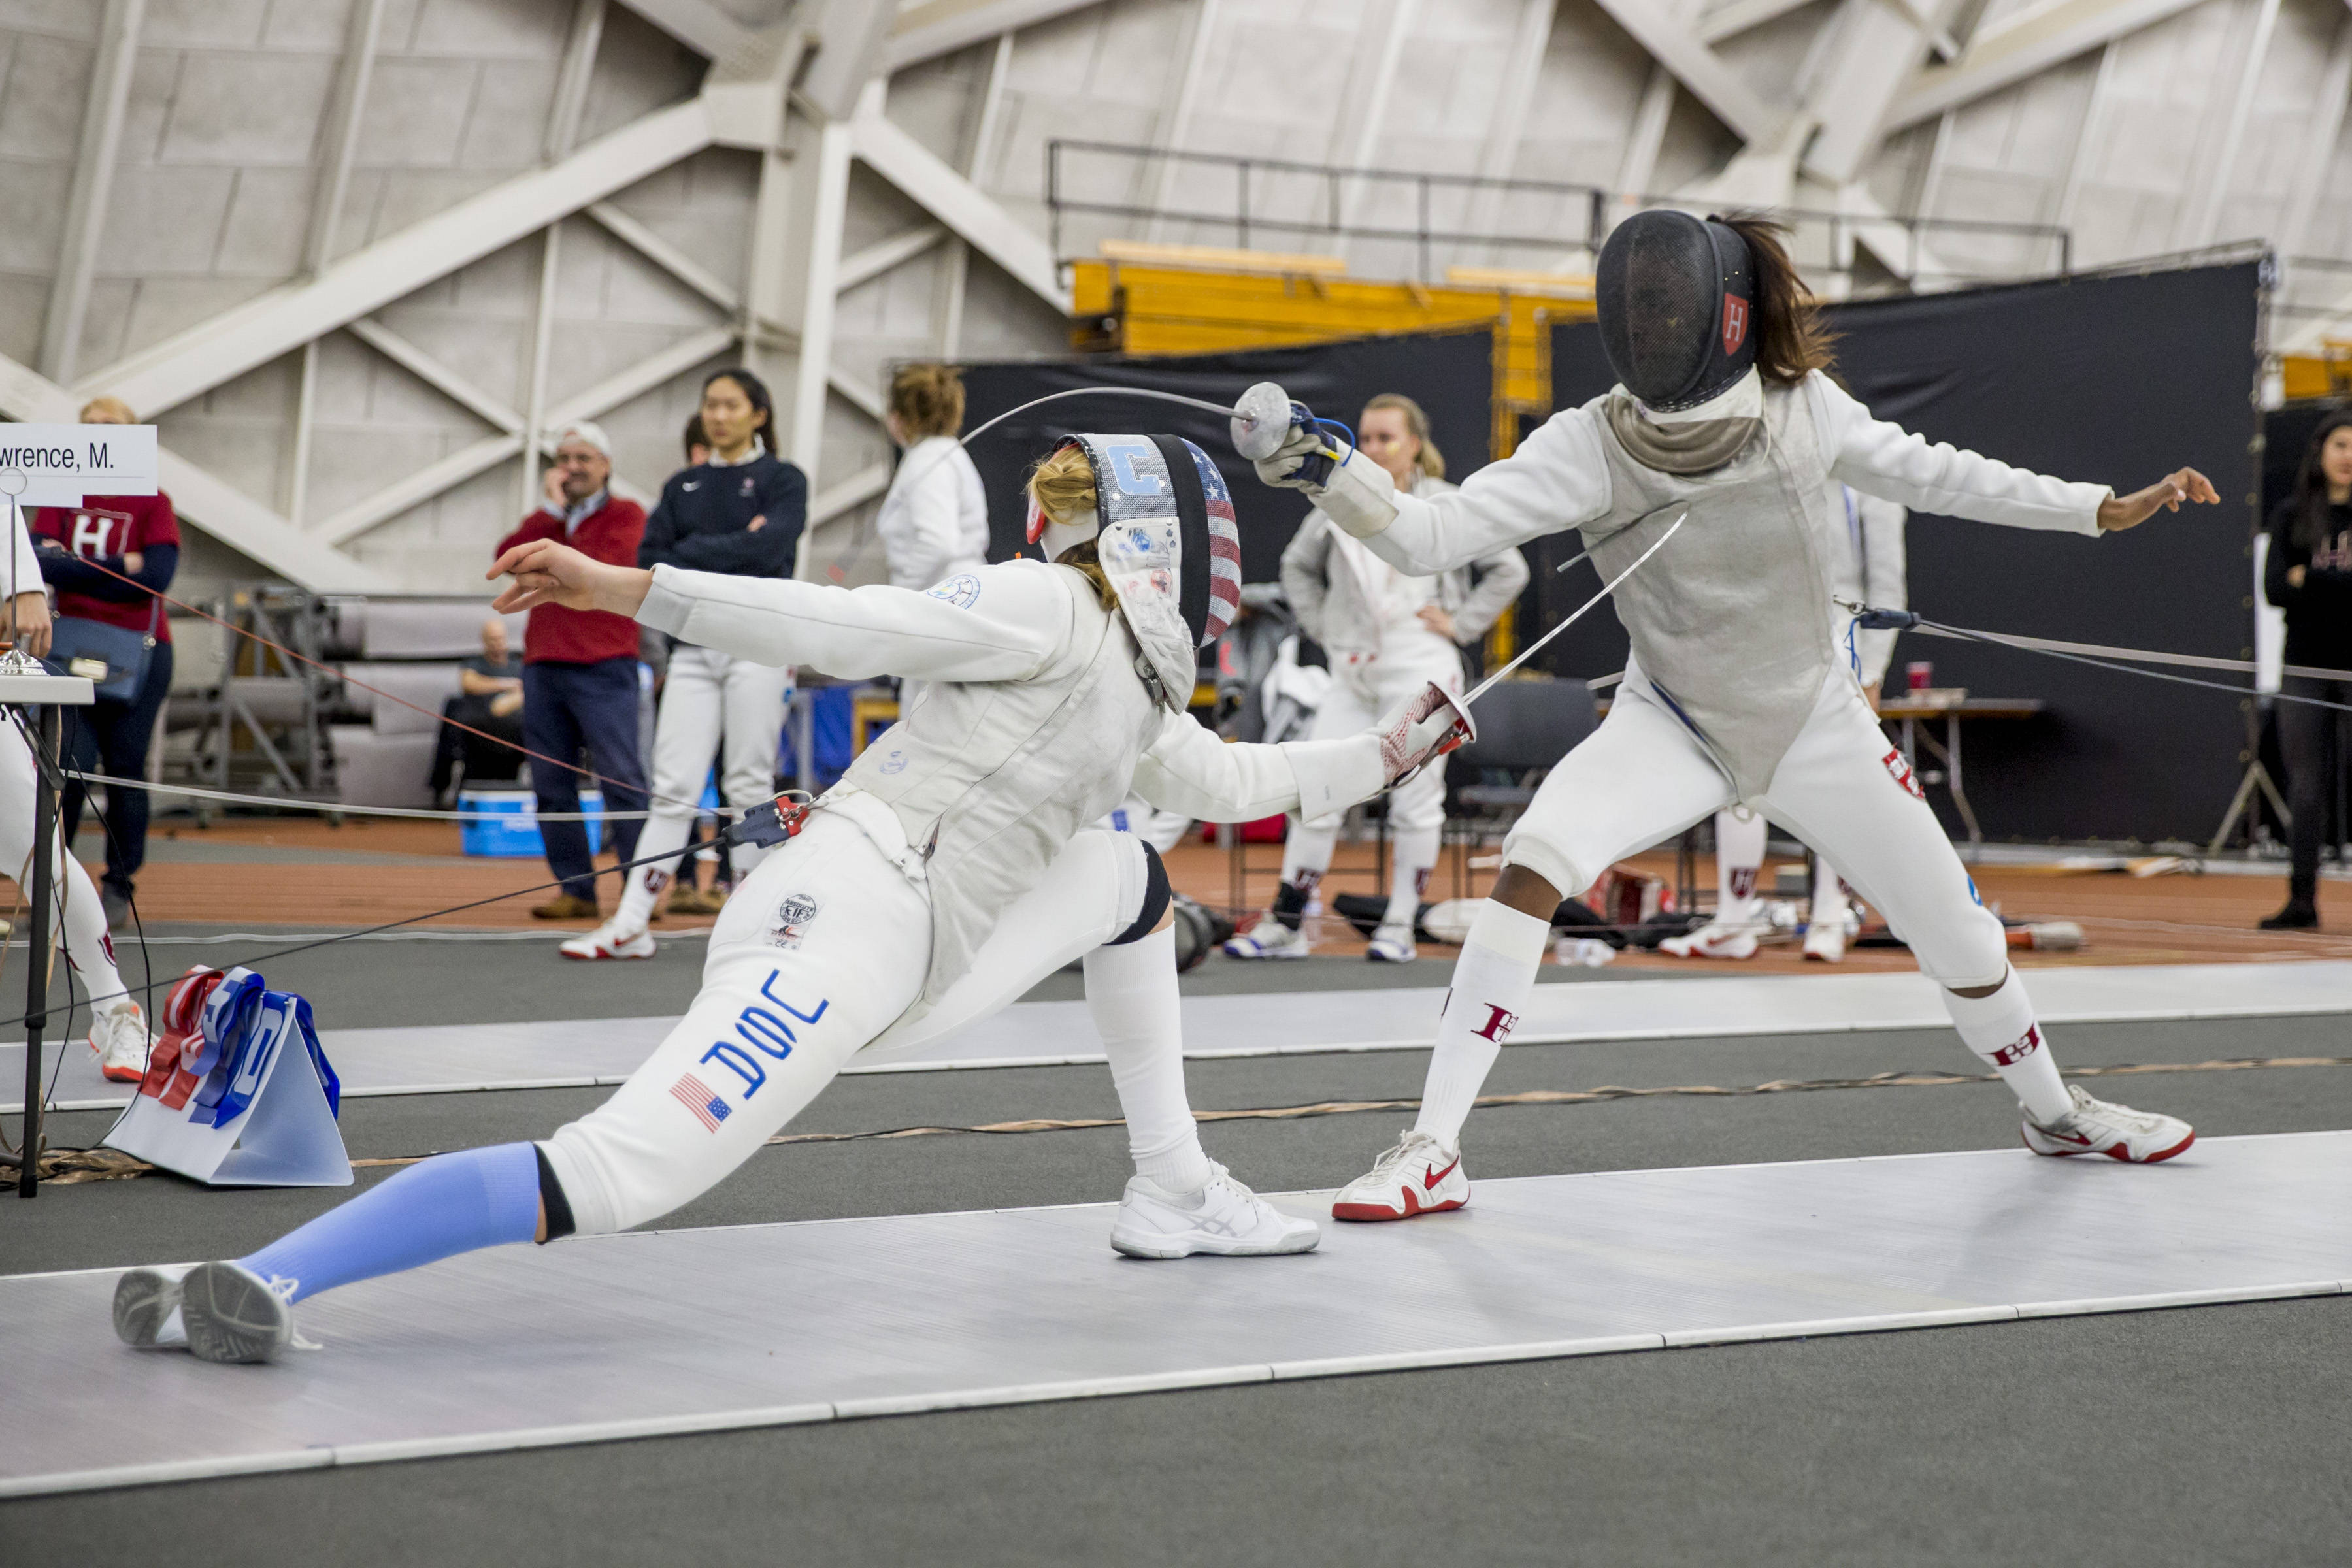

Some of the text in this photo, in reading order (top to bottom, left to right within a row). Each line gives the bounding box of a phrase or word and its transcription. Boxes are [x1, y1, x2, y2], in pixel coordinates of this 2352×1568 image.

[1725, 303, 1744, 342] H
[89, 442, 114, 469] M.
[1106, 444, 1163, 496] C
[72, 514, 114, 561] H
